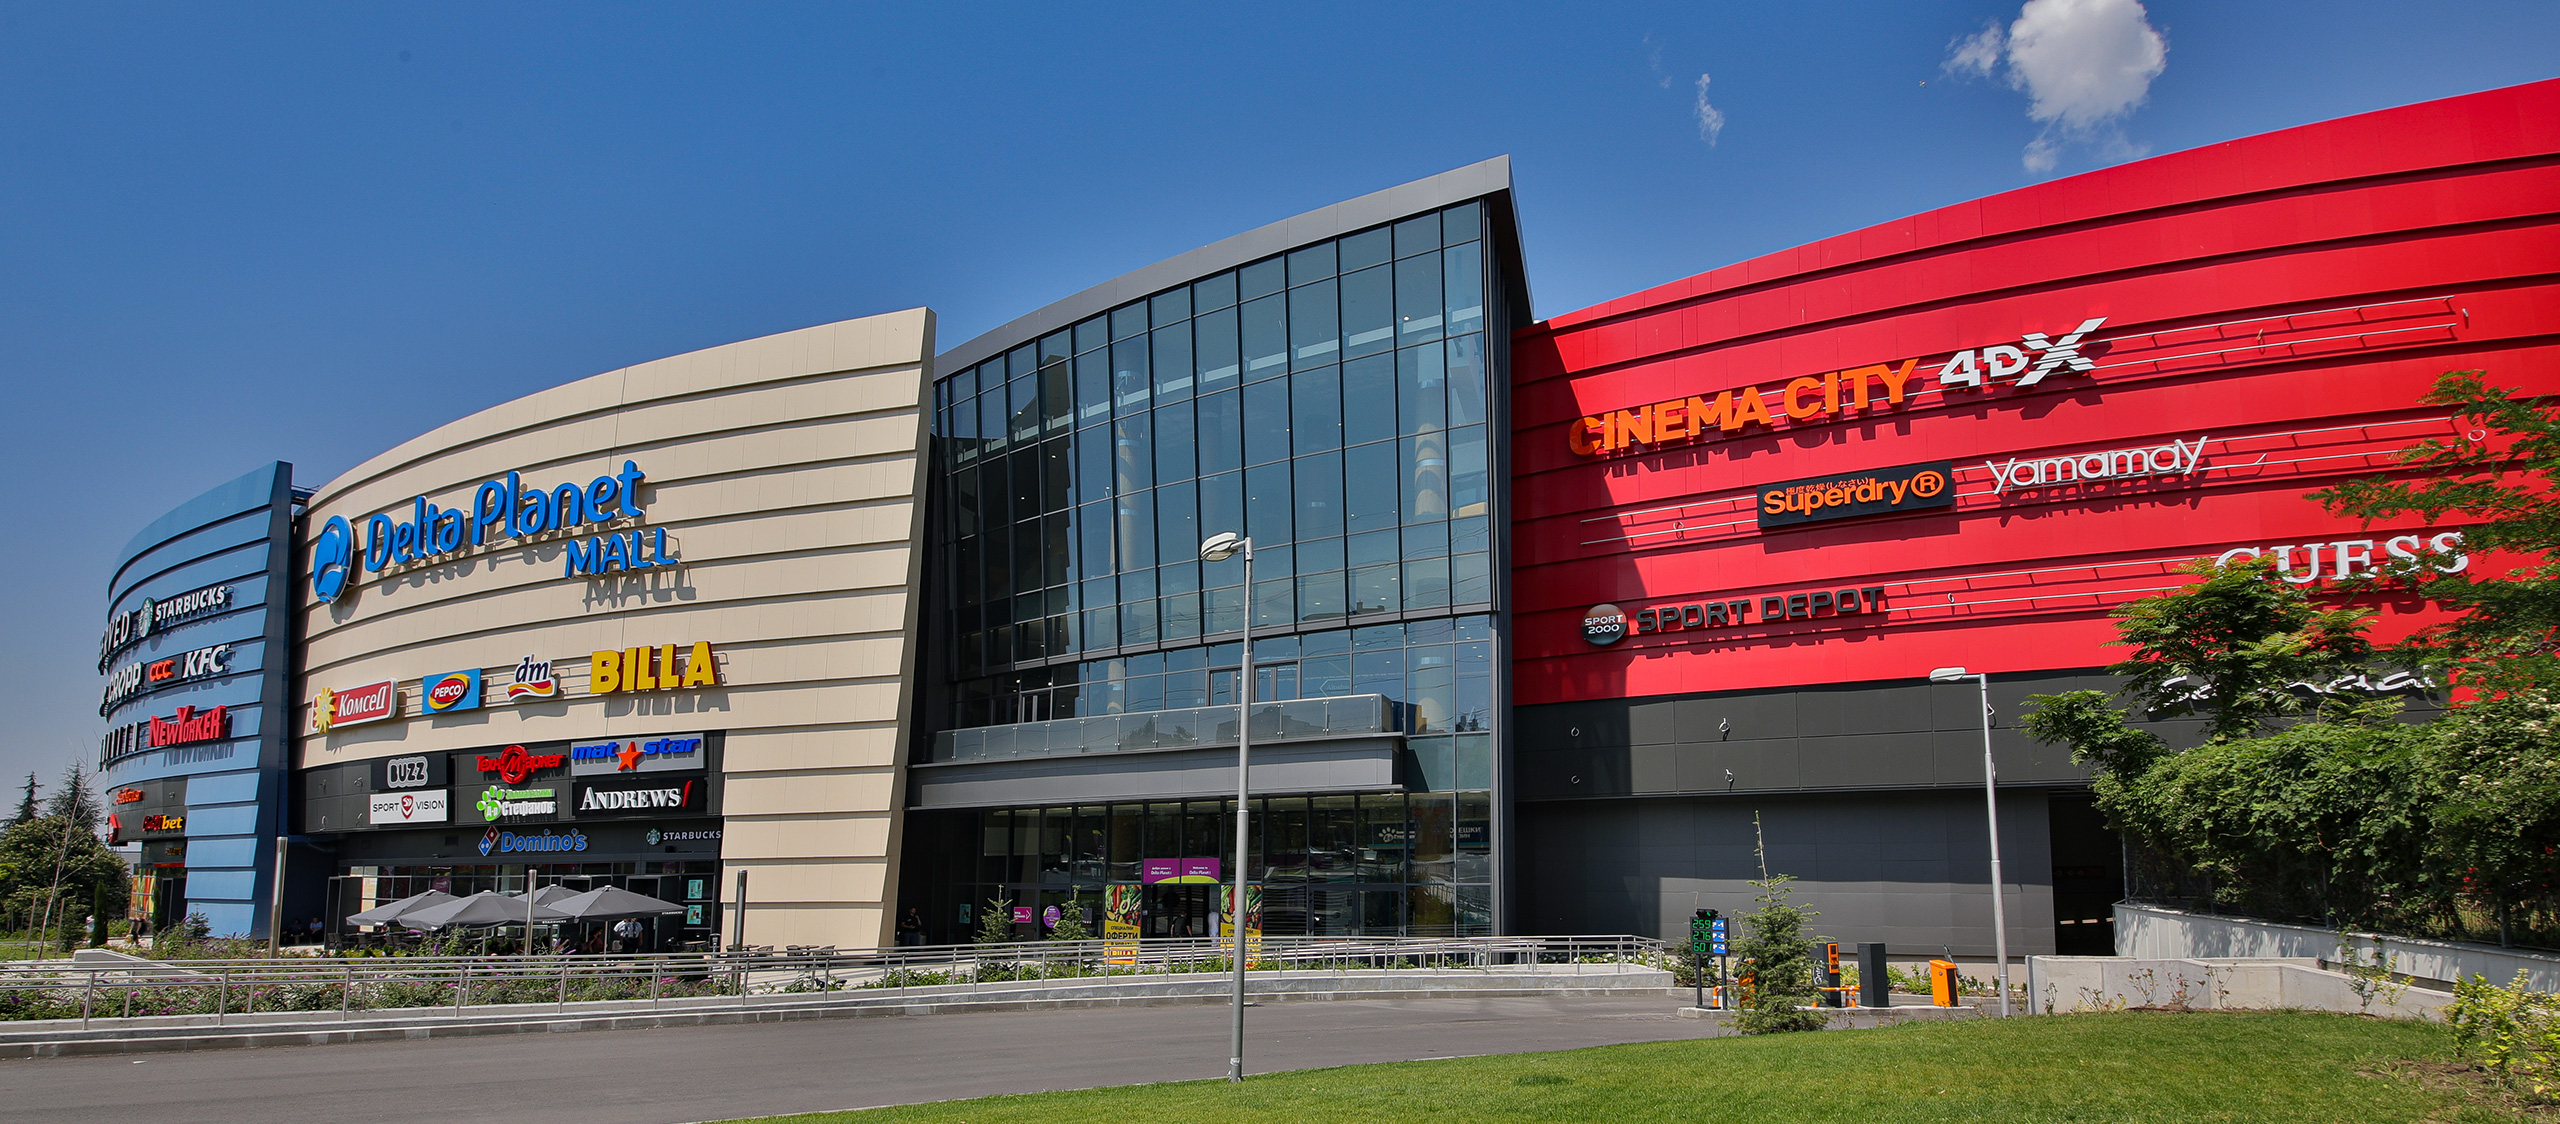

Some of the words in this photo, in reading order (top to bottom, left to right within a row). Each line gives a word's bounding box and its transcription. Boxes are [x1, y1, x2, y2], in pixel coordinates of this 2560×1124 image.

[1569, 386, 1773, 456] CINEMA
[1782, 358, 1919, 418] CITY
[1938, 317, 2108, 388] 4DX
[364, 496, 465, 572] Delta
[471, 460, 647, 546] Planet
[564, 527, 681, 578] MALL
[155, 585, 227, 622] STARBUCKS
[1635, 598, 1750, 632] SPORT
[1761, 586, 1885, 620] DEPOT
[1584, 614, 1624, 627] SPORT
[1588, 623, 1620, 635] 2000
[149, 660, 176, 681] CCC
[183, 644, 228, 678] KFC
[515, 655, 550, 684] dm
[589, 640, 717, 695] BILLA
[434, 684, 464, 699] PEPCO
[571, 741, 620, 760] mat
[643, 738, 701, 755] star
[389, 759, 426, 785] BUZZ
[373, 803, 399, 812] SPORT
[416, 799, 445, 810] VISION
[501, 828, 588, 852] Domino's
[663, 830, 722, 840] STARBUCKS
[1692, 919, 1711, 929] 259
[1692, 930, 1711, 940] 276
[1106, 931, 1138, 940] ОФЕРТИ
[1693, 942, 1712, 952] 601
